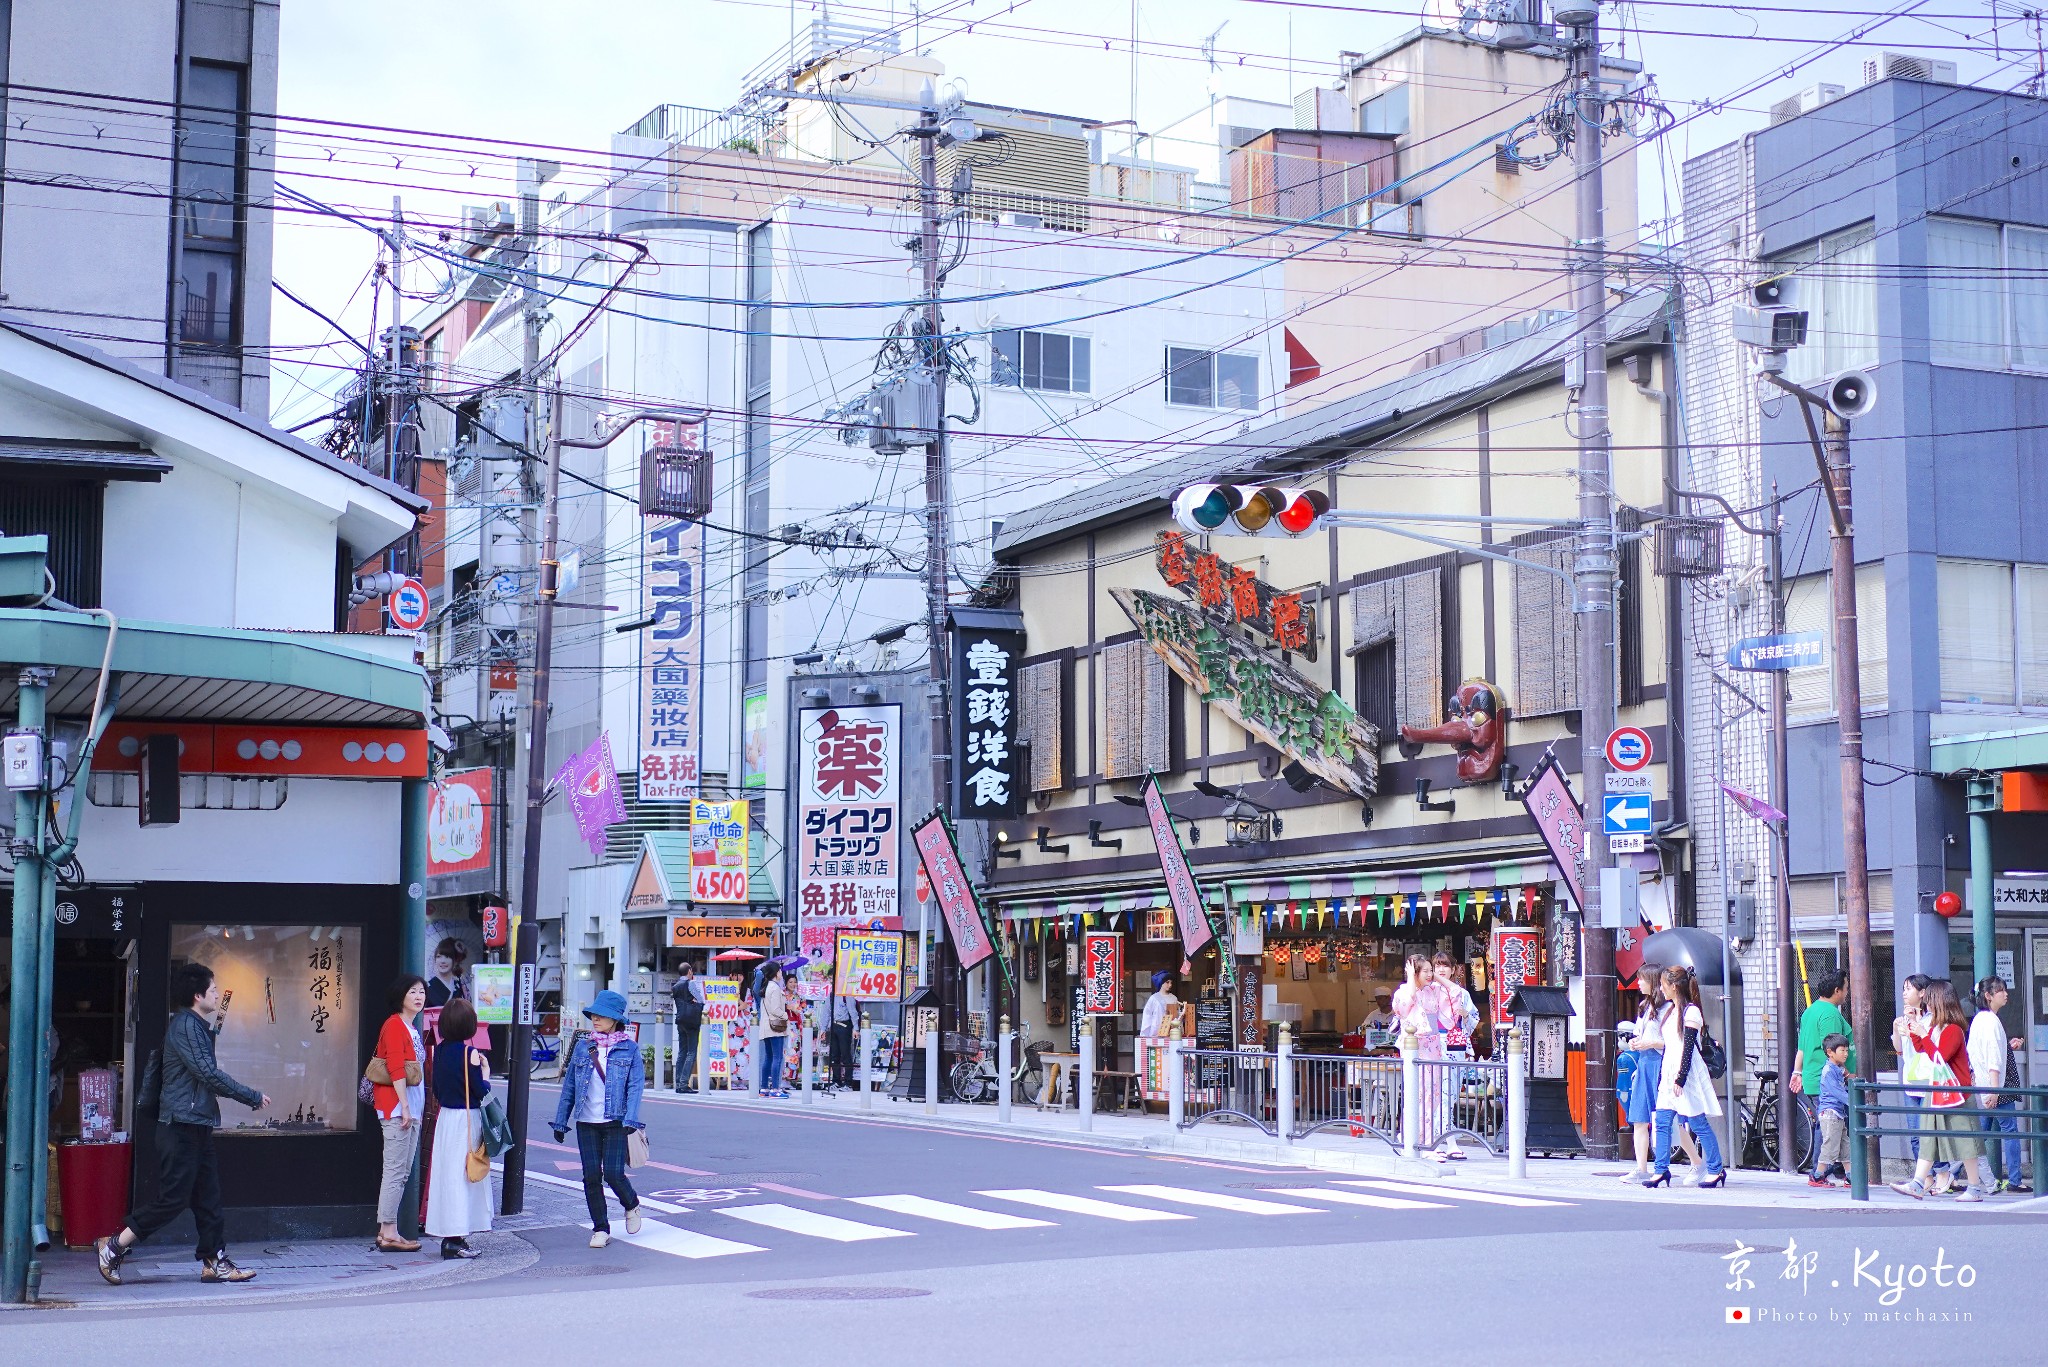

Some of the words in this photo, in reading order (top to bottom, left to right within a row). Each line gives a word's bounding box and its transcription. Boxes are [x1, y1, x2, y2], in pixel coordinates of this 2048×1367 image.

[651, 519, 692, 640] イコク
[13, 759, 28, 769] 5P
[641, 754, 697, 781] 免税
[816, 722, 885, 797] 薬
[643, 783, 696, 797] Tax-Free
[1608, 777, 1651, 787] マイクロを除く
[695, 803, 731, 819] 合利
[806, 807, 892, 834] ダイコク
[708, 822, 742, 838] 他命
[815, 836, 881, 858] ドラッグ
[801, 883, 857, 917] 免税
[858, 886, 896, 899] Tax-Free
[863, 900, 890, 913] 면세
[486, 909, 498, 939] うどん
[676, 926, 731, 937] COFFEE
[861, 953, 898, 966] 护唇膏
[710, 1061, 725, 1072] 98
